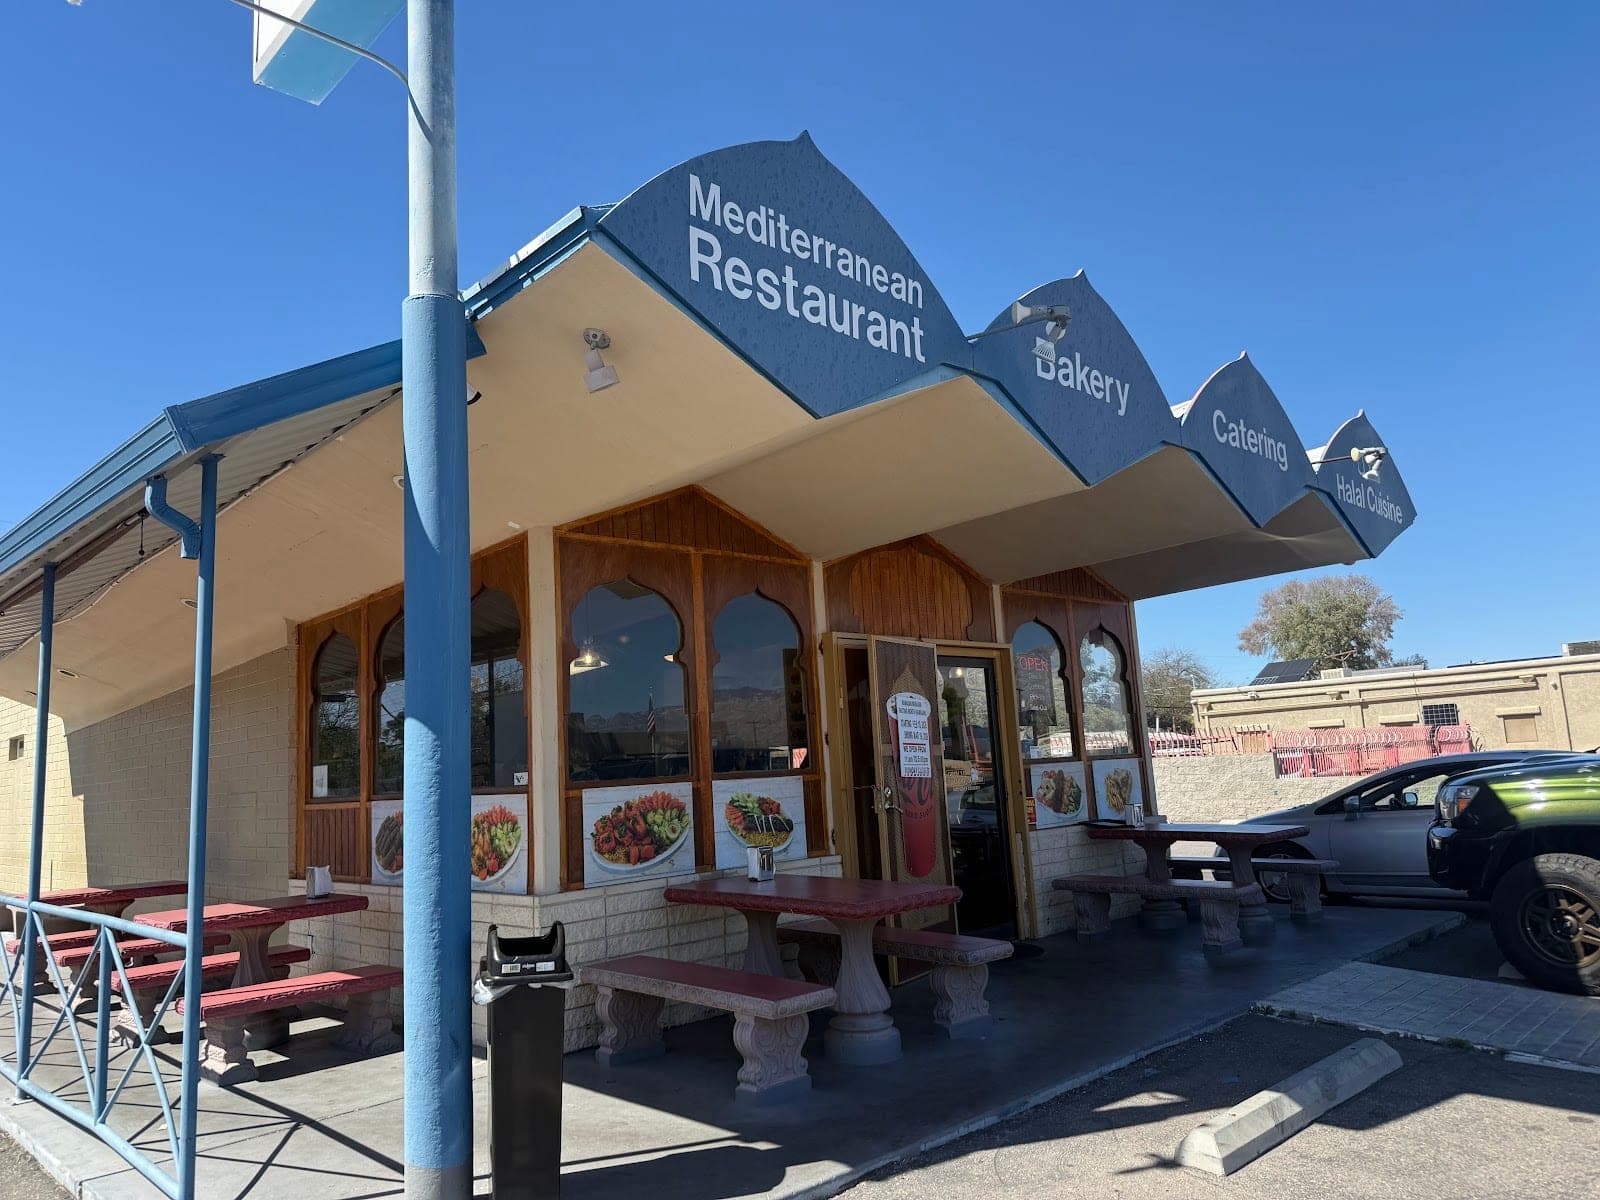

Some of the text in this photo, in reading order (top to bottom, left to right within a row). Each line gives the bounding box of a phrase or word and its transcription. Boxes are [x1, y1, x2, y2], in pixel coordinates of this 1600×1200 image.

[689, 173, 923, 308] Mediterranean
[689, 225, 926, 363] Restaurant
[1213, 409, 1288, 471] Catering
[1336, 473, 1403, 524] Halal Cuisine
[1019, 656, 1049, 672] OPEN
